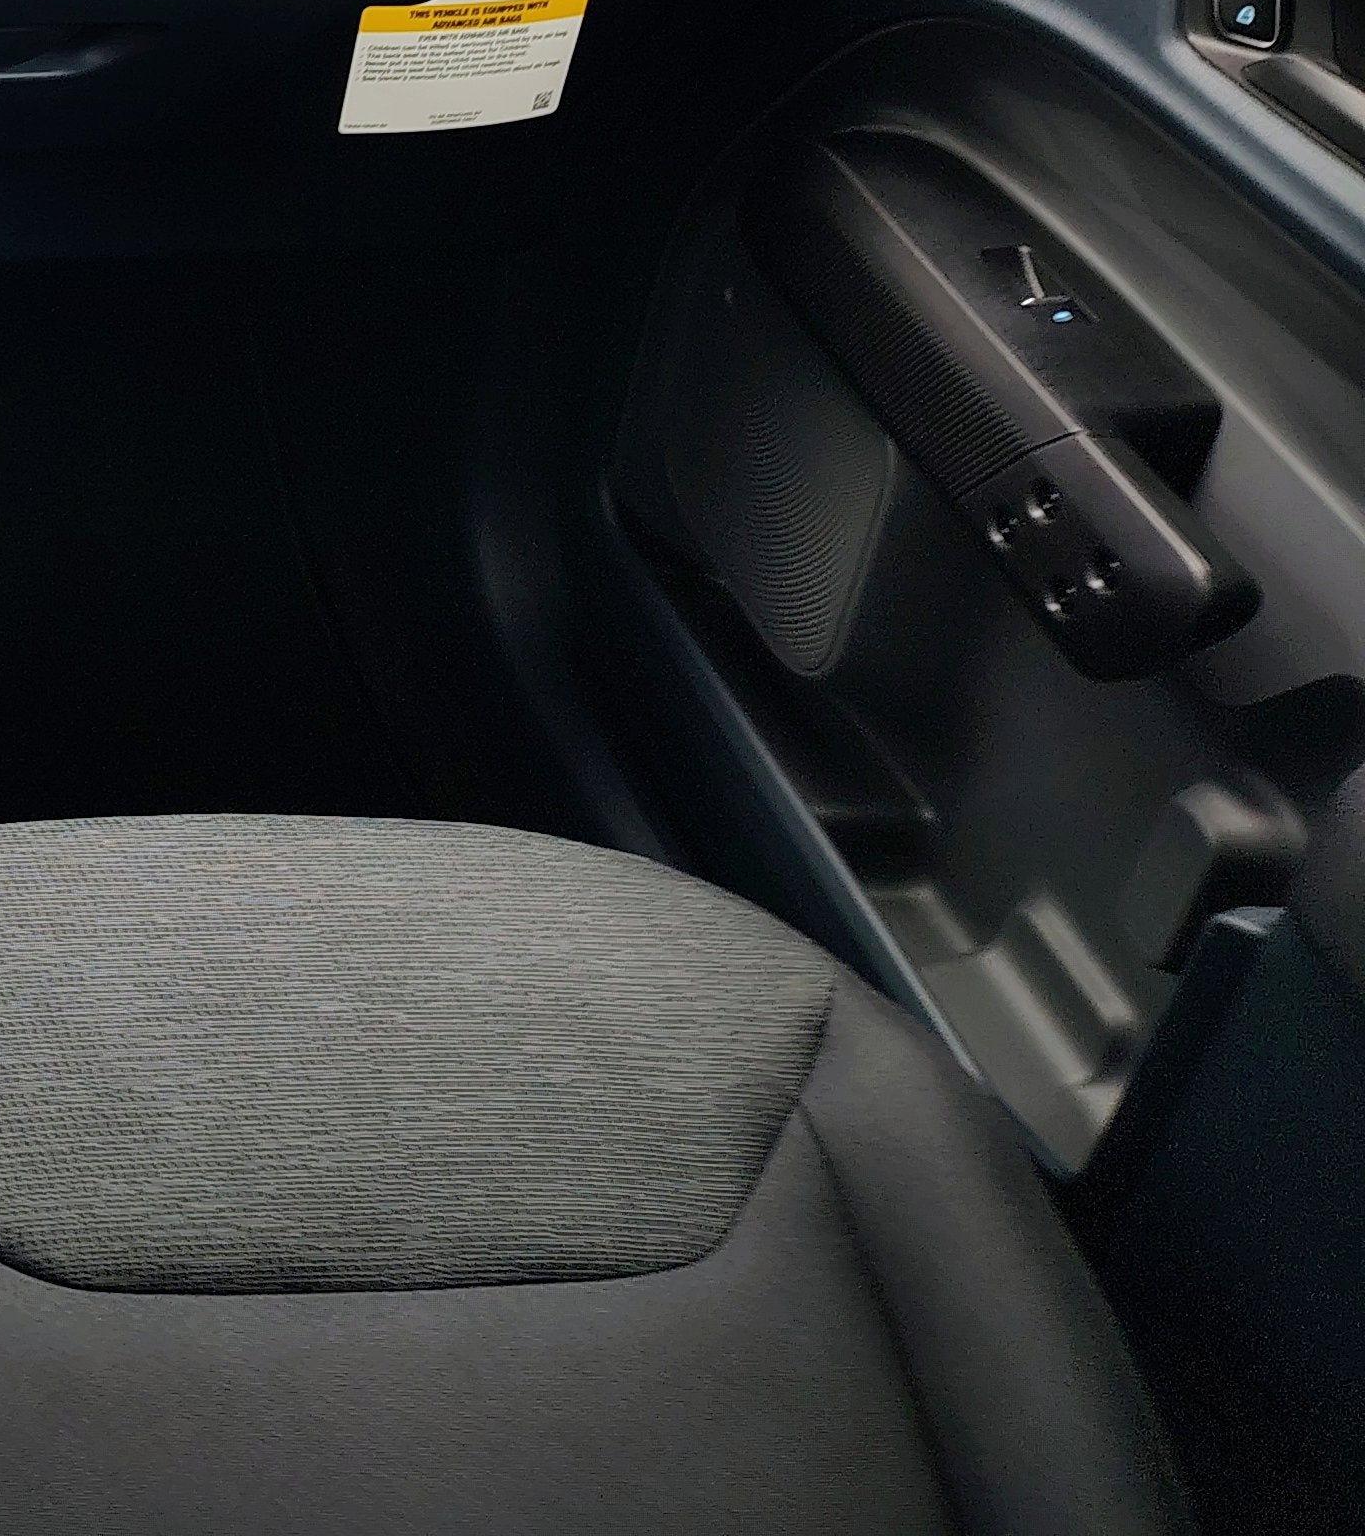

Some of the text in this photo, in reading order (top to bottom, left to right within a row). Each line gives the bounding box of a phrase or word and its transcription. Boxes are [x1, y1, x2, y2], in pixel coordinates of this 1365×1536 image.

[410, 9, 430, 19] THIS
[470, 7, 480, 16] IS
[527, 0, 549, 11] WITH
